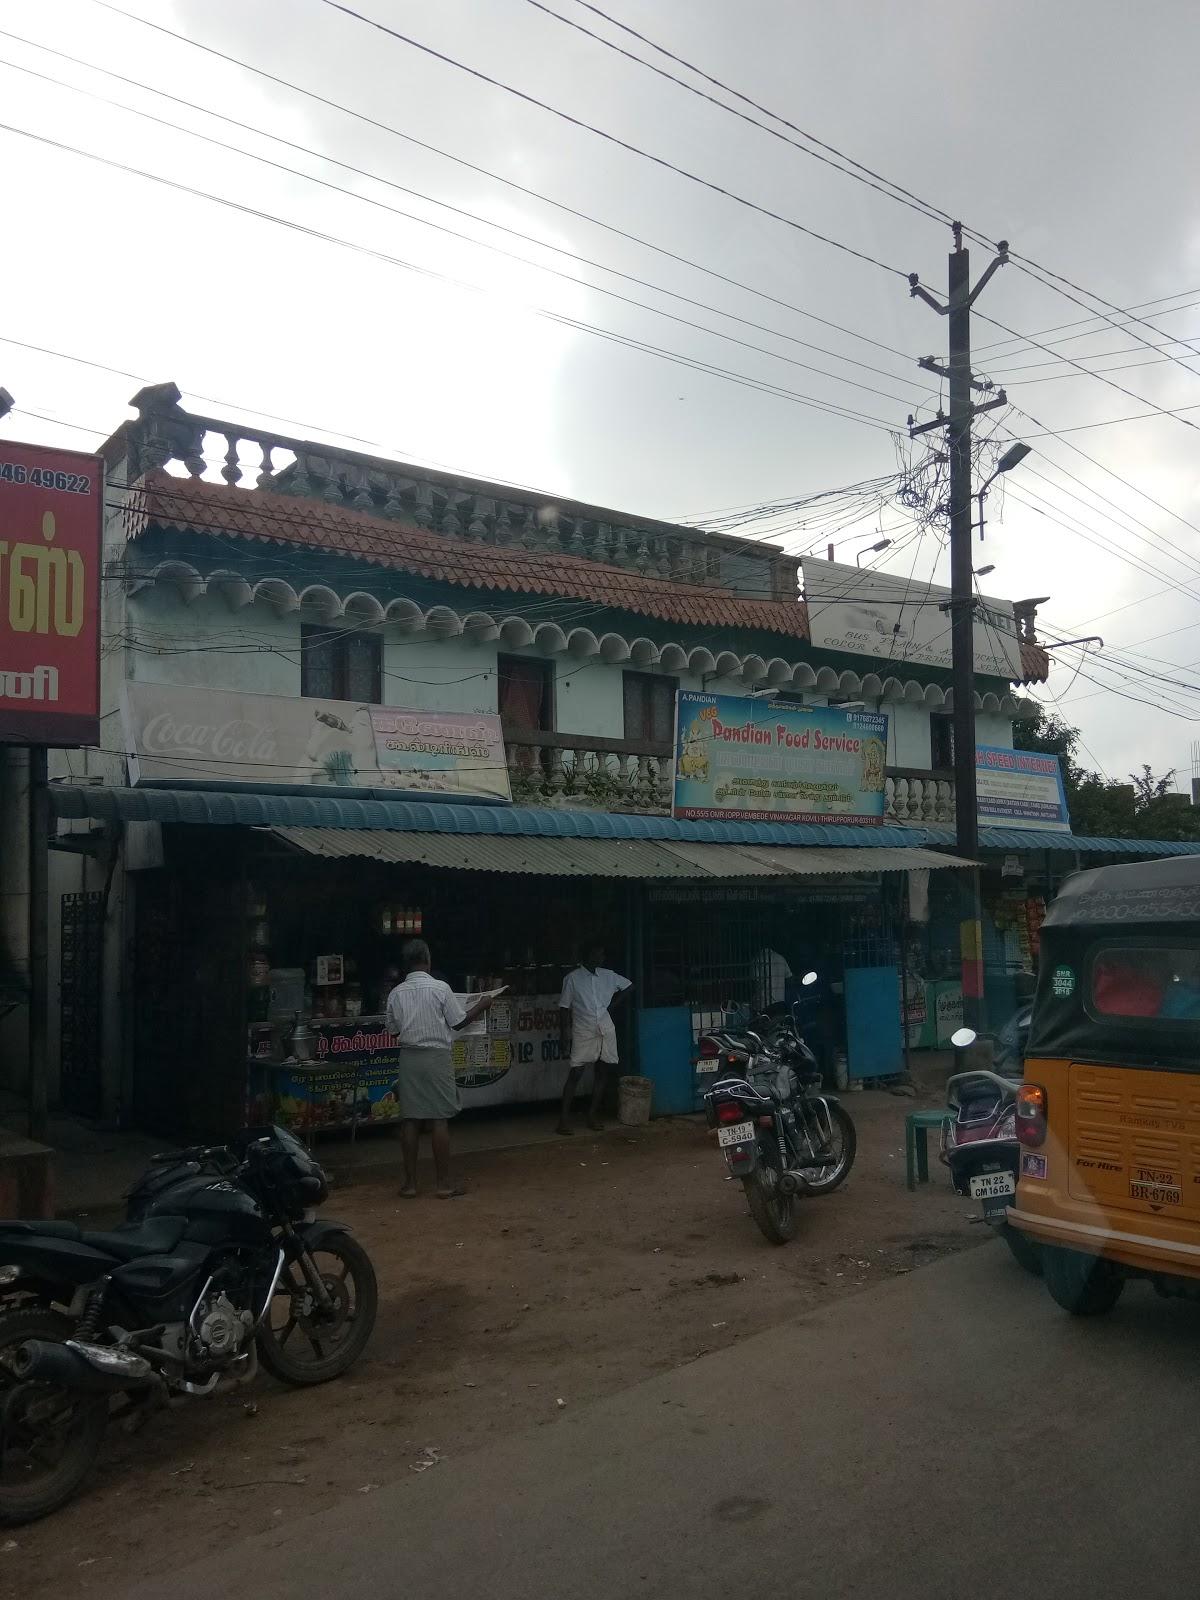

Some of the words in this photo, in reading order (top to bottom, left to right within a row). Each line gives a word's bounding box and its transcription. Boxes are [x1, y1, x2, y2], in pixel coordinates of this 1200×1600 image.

[30, 468, 91, 495] 49622
[823, 638, 865, 651] COLOR
[142, 712, 277, 762] Coca-Cola
[710, 718, 772, 747] Pandian
[776, 723, 811, 750] Food
[813, 728, 861, 754] Service
[986, 752, 1015, 770] SPEED
[1016, 756, 1058, 774] INTERNET
[1076, 1158, 1096, 1169] For
[1097, 1161, 1123, 1172] Hire
[981, 1177, 992, 1187] TN
[993, 1176, 1004, 1185] 22
